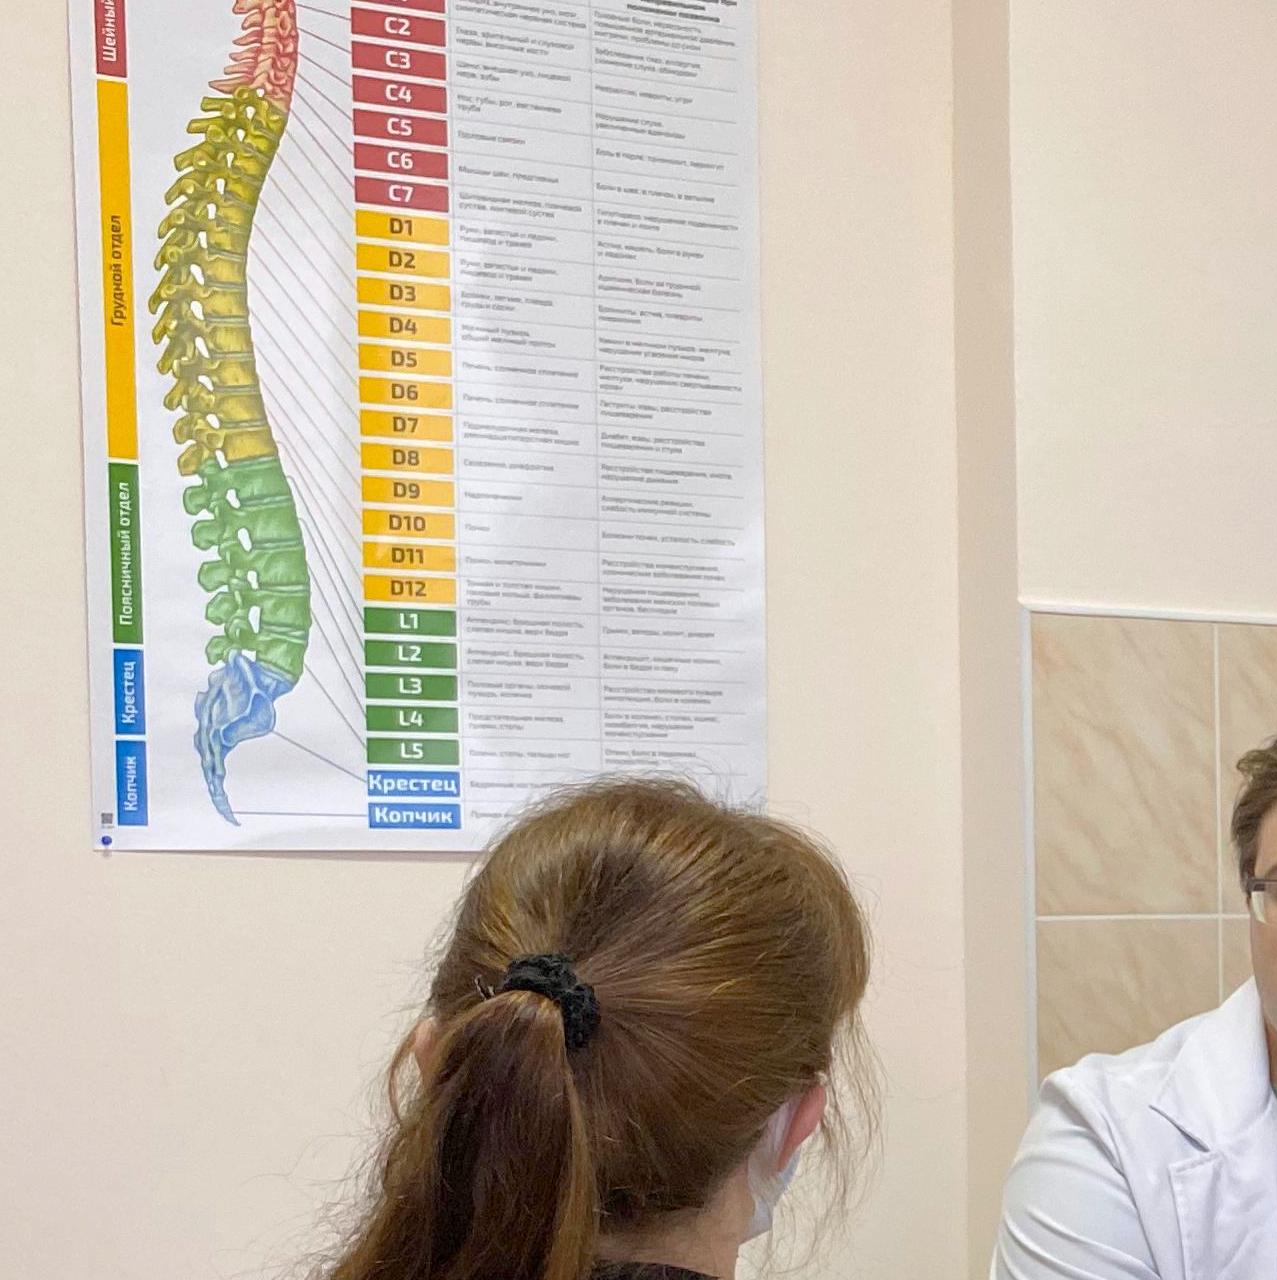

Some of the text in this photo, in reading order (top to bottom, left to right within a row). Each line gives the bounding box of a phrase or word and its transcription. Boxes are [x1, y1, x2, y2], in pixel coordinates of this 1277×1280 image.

[384, 16, 411, 37] C2
[384, 50, 411, 70] C3
[385, 84, 411, 103] C4
[386, 117, 412, 136] C5
[387, 151, 413, 170] C6
[387, 184, 413, 202] C7
[388, 217, 413, 236] D1
[388, 250, 415, 269] D2
[110, 216, 127, 326] Грудной отдел
[388, 284, 415, 302] D3
[388, 317, 416, 335] D4
[390, 350, 417, 368] D5
[391, 383, 418, 401] D6
[391, 416, 418, 434] D7
[392, 449, 419, 467] D8
[393, 483, 420, 499] D9
[389, 515, 426, 532] D10
[119, 482, 135, 626] Поясничный отдел
[391, 547, 424, 565] D11
[390, 580, 426, 597] D12
[400, 613, 419, 629] L1
[398, 645, 422, 662] L2
[122, 661, 136, 724] Крестец
[399, 678, 422, 694] L3
[399, 710, 423, 727] L4
[400, 743, 423, 759] L5
[126, 755, 138, 812] Копчик
[369, 774, 457, 795] Крестец
[374, 806, 453, 825] Копчик
